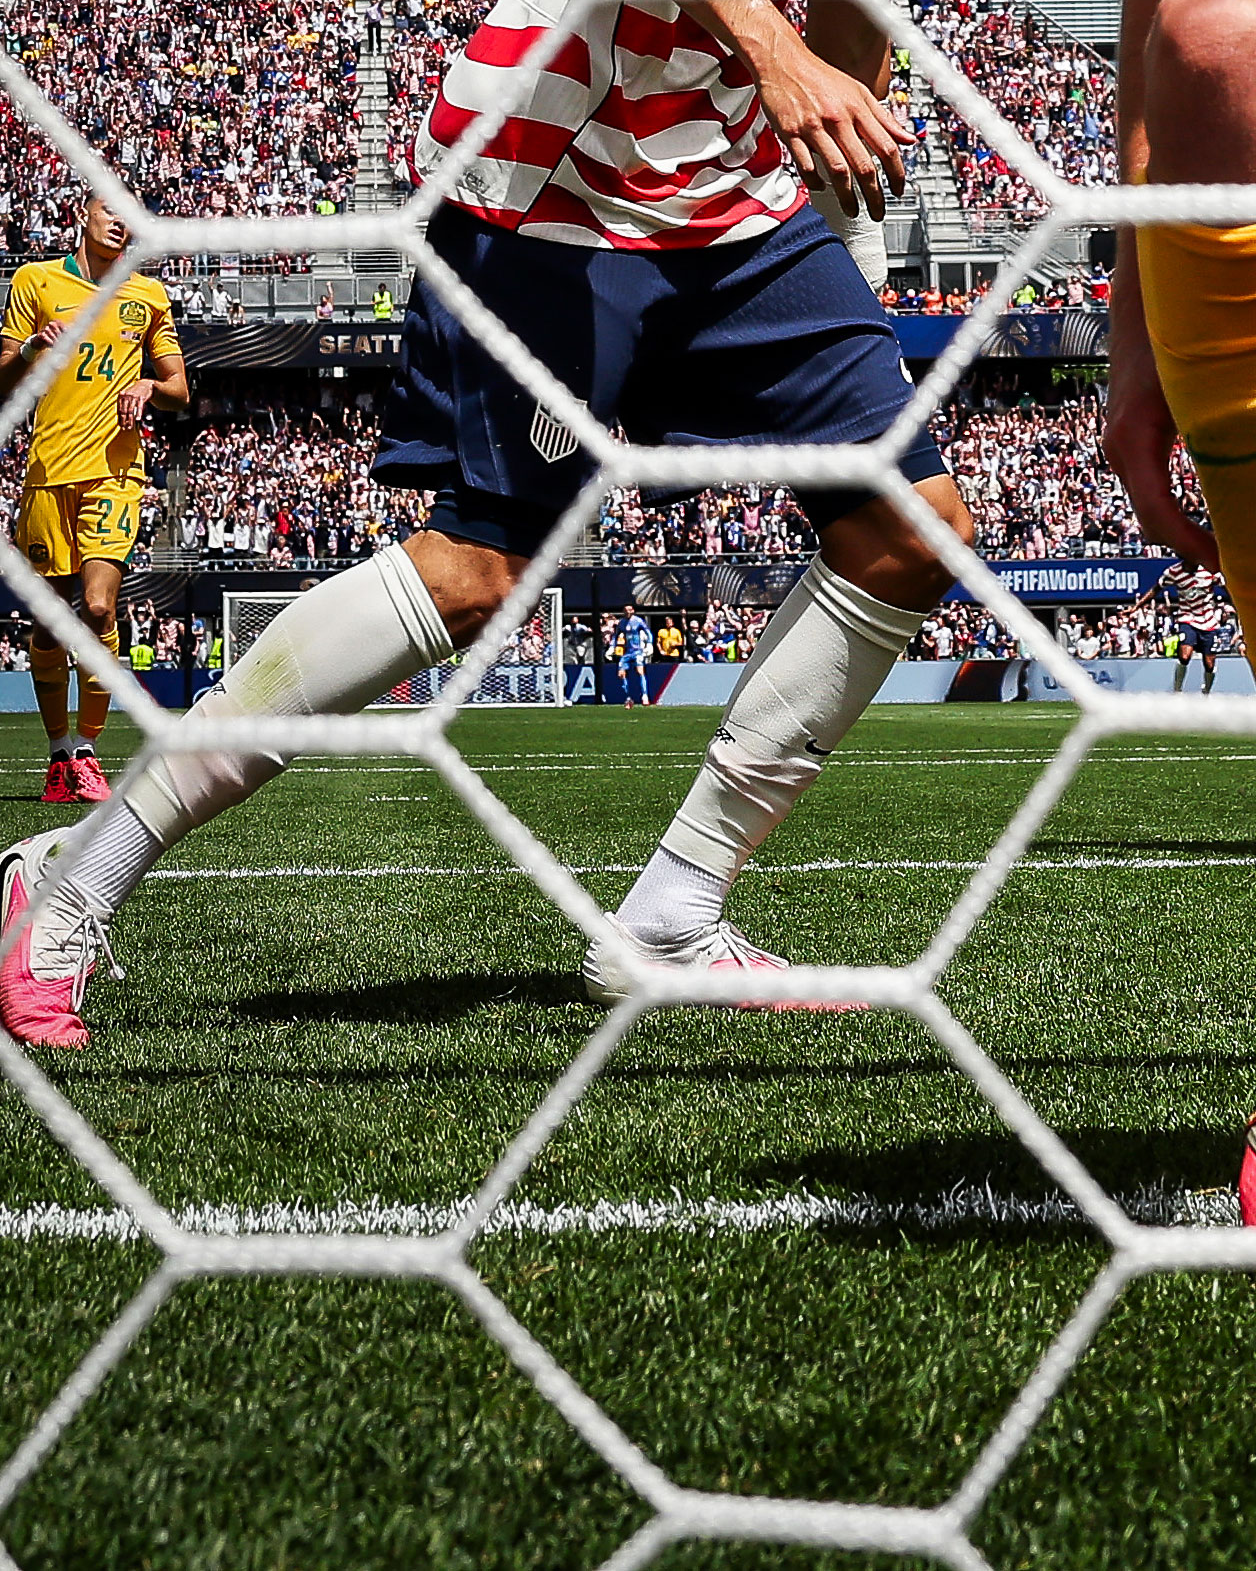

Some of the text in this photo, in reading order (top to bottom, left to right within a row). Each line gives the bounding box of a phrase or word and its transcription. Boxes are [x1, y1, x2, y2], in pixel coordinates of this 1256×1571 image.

[319, 334, 402, 354] SEATT
[76, 342, 115, 382] 24
[96, 499, 132, 538] 24
[999, 567, 1139, 593] #FIFAWorldCup
